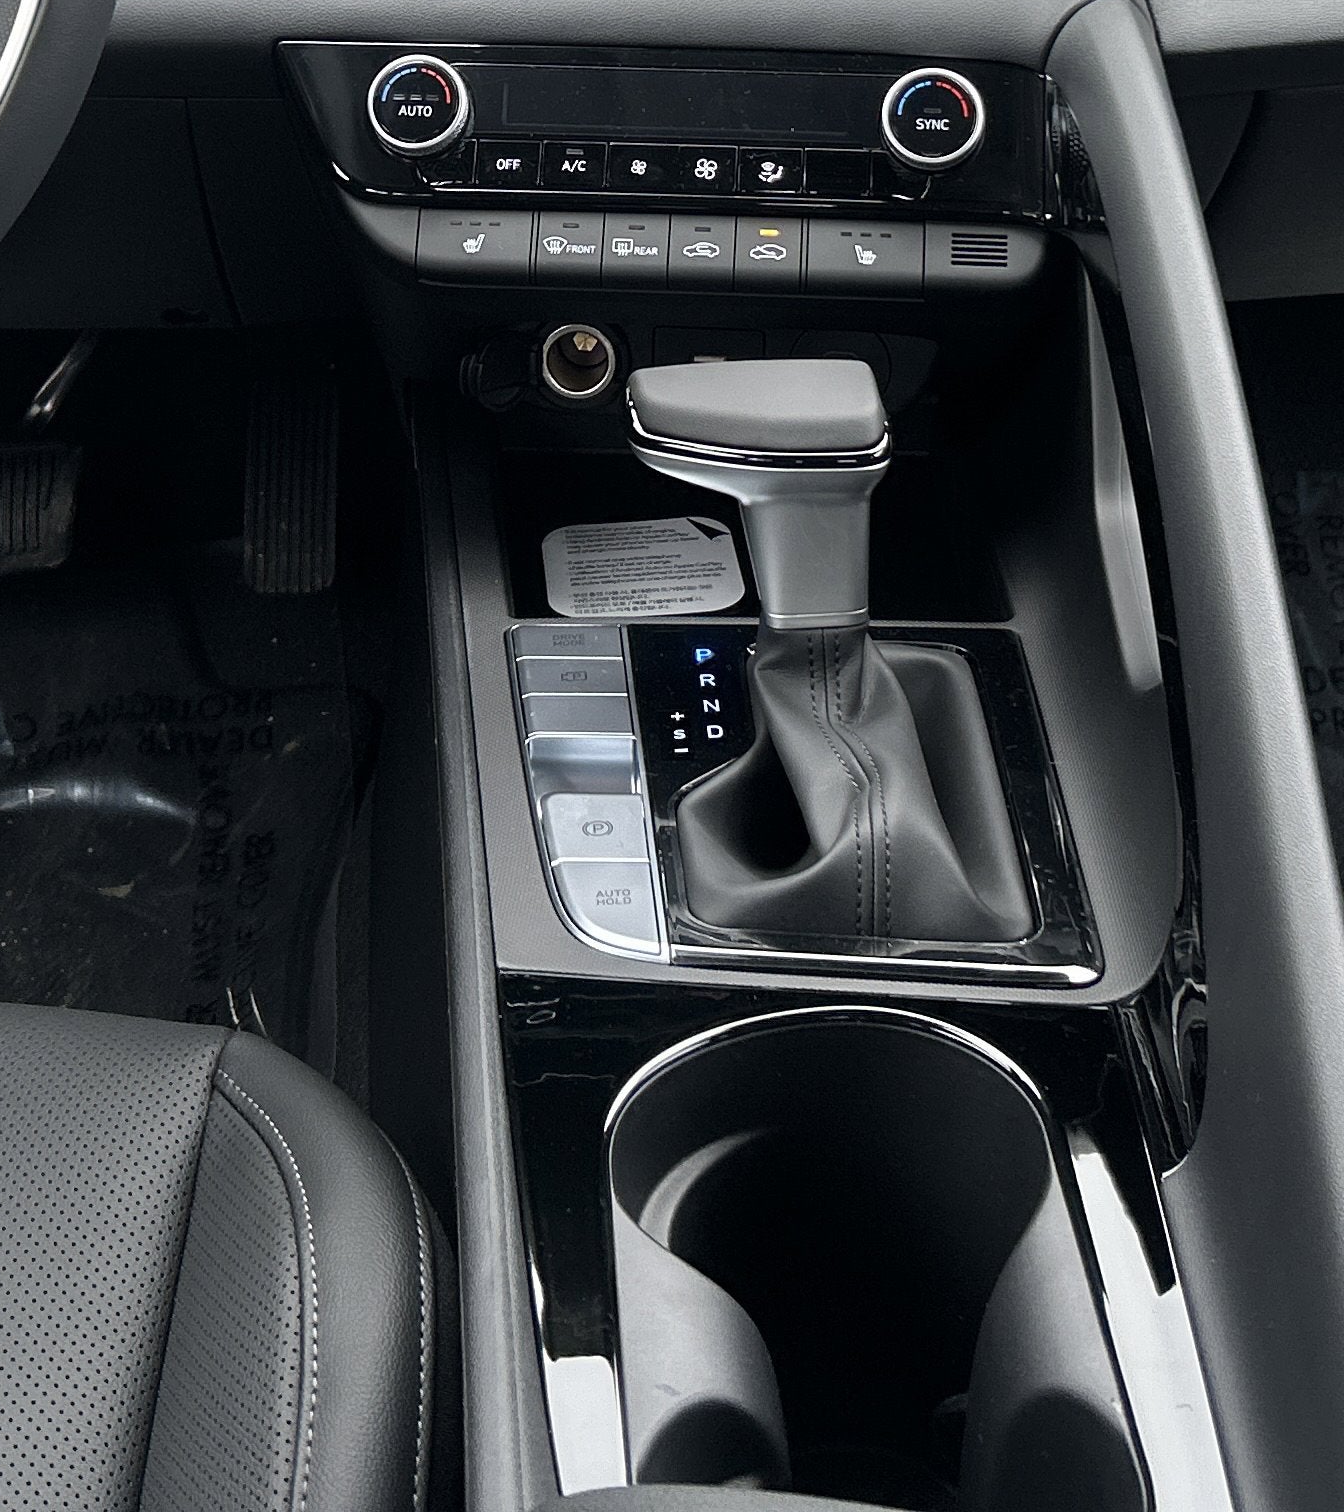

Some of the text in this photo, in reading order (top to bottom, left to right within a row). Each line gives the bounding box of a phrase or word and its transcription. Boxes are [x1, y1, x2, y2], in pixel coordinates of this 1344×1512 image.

[397, 105, 433, 118] AUTO
[916, 118, 950, 131] SYNC
[496, 159, 521, 171] OFF
[561, 160, 587, 173] A/C
[565, 244, 596, 255] FRONT
[634, 245, 659, 256] REAR
[695, 648, 713, 662] P
[699, 673, 716, 686] R
[703, 699, 720, 712] N
[674, 729, 686, 740] S
[707, 725, 724, 739] D
[596, 888, 631, 897] AUTO
[596, 897, 632, 906] HOLD
